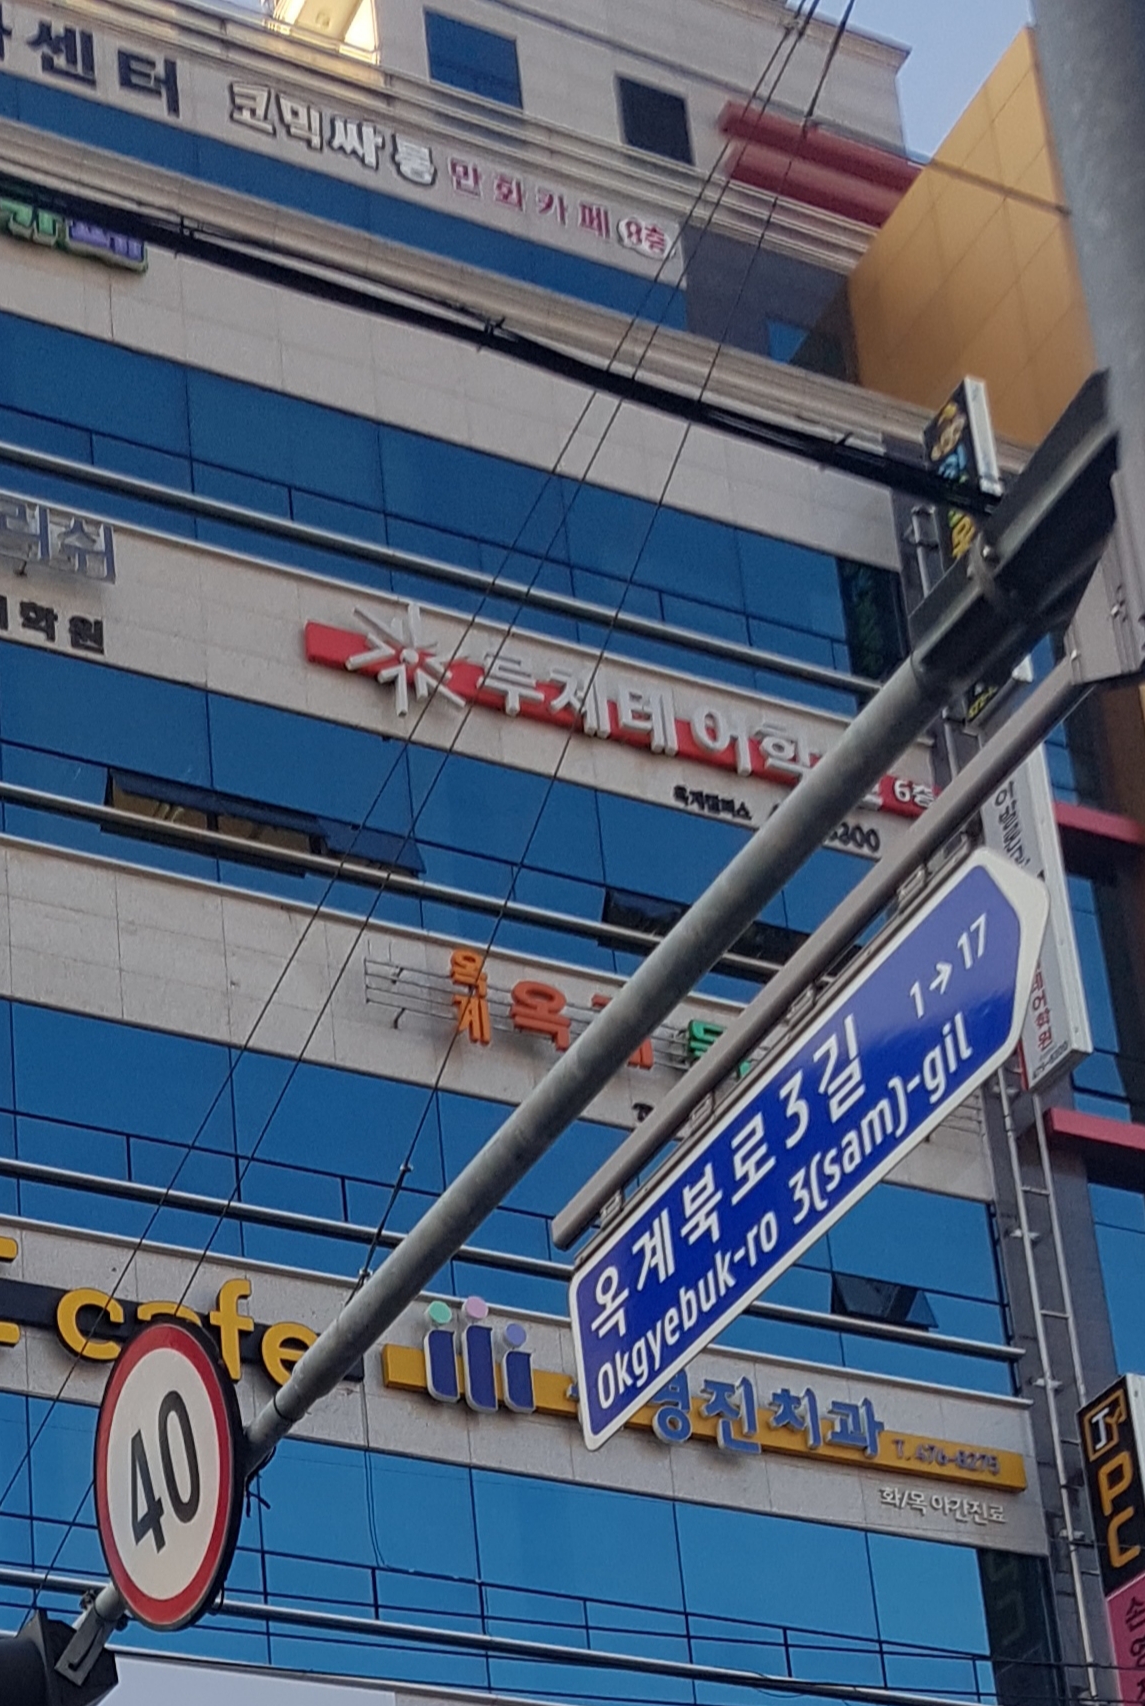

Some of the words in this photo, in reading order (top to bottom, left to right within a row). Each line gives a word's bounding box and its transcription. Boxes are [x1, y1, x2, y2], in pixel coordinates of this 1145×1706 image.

[448, 157, 611, 242] 만화카페
[909, 980, 925, 1019] 1
[957, 913, 990, 972] 17
[591, 1015, 866, 1338] 옥계북로3길
[596, 1209, 780, 1412] Okgyebuk-ro
[791, 1013, 974, 1226] 3(sam)-gil
[130, 1390, 201, 1553] 40
